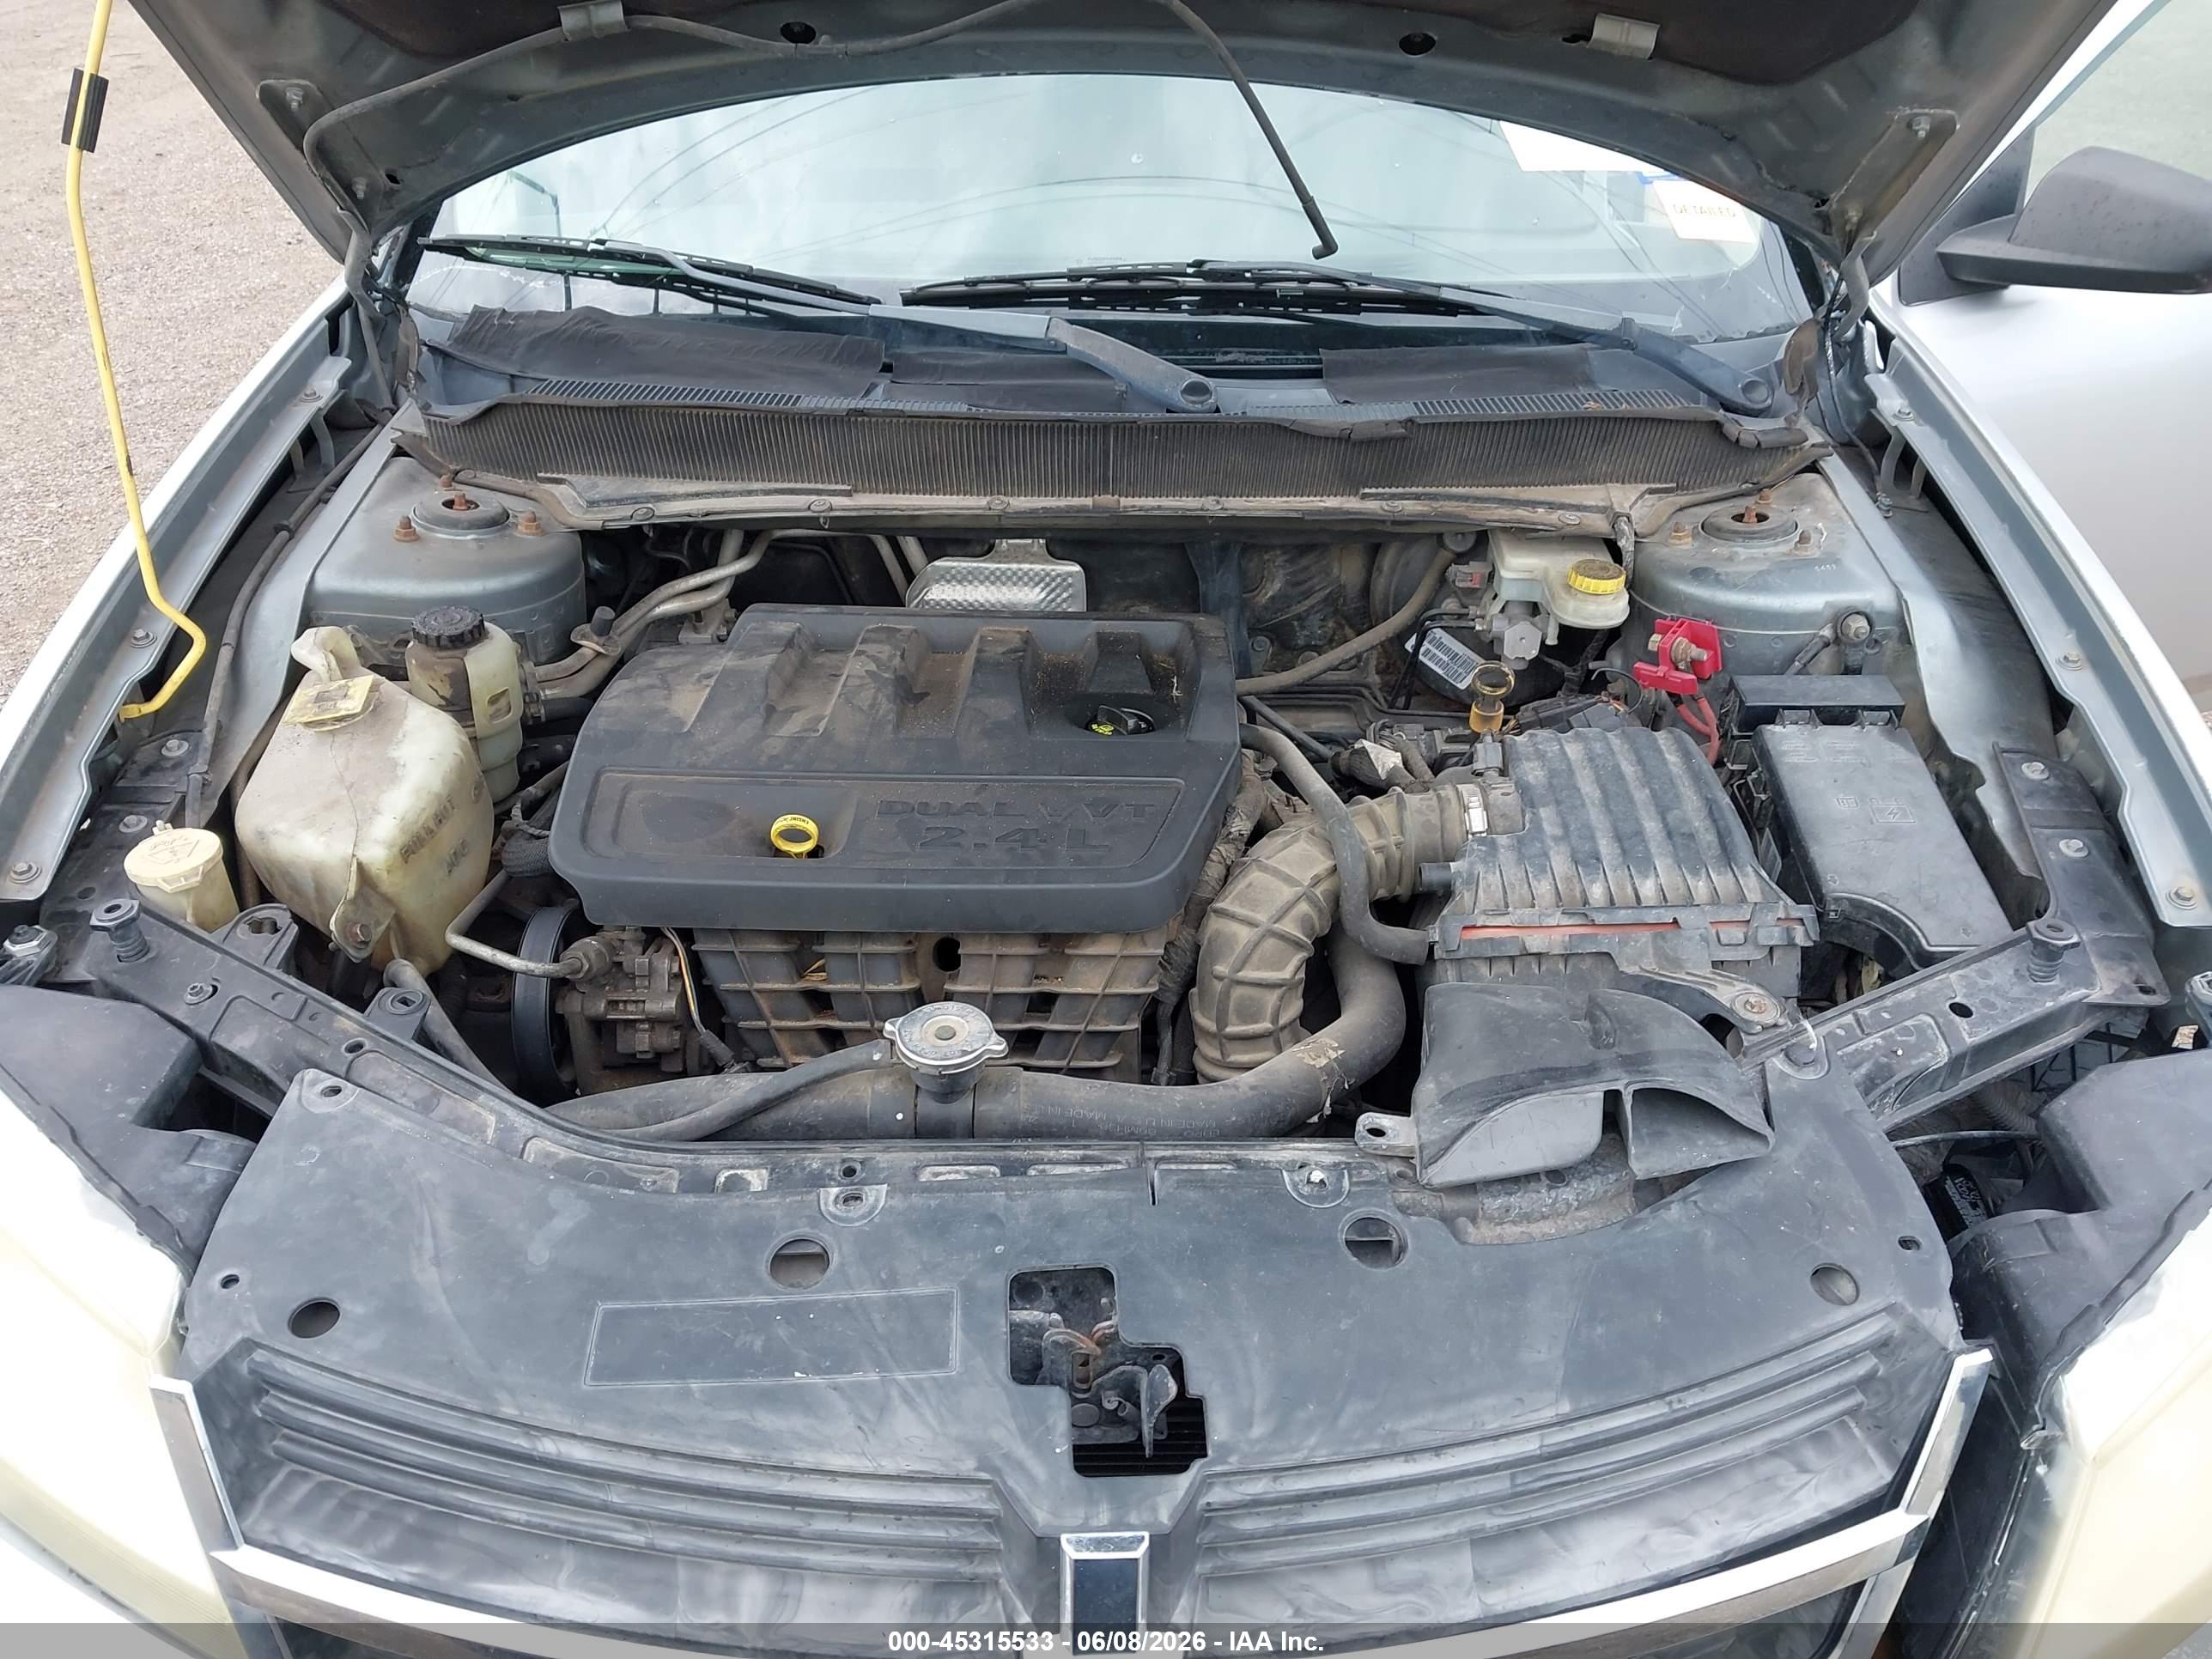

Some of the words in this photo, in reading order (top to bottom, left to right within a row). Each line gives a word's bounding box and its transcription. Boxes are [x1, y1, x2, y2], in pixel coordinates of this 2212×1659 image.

[1673, 204, 1736, 217] DETAILED
[876, 799, 1025, 819] DUAL
[1037, 800, 1157, 822] VVT
[1062, 1106, 1107, 1121] MADE
[1160, 1118, 1173, 1127] IN
[1177, 1118, 1216, 1128] MADE
